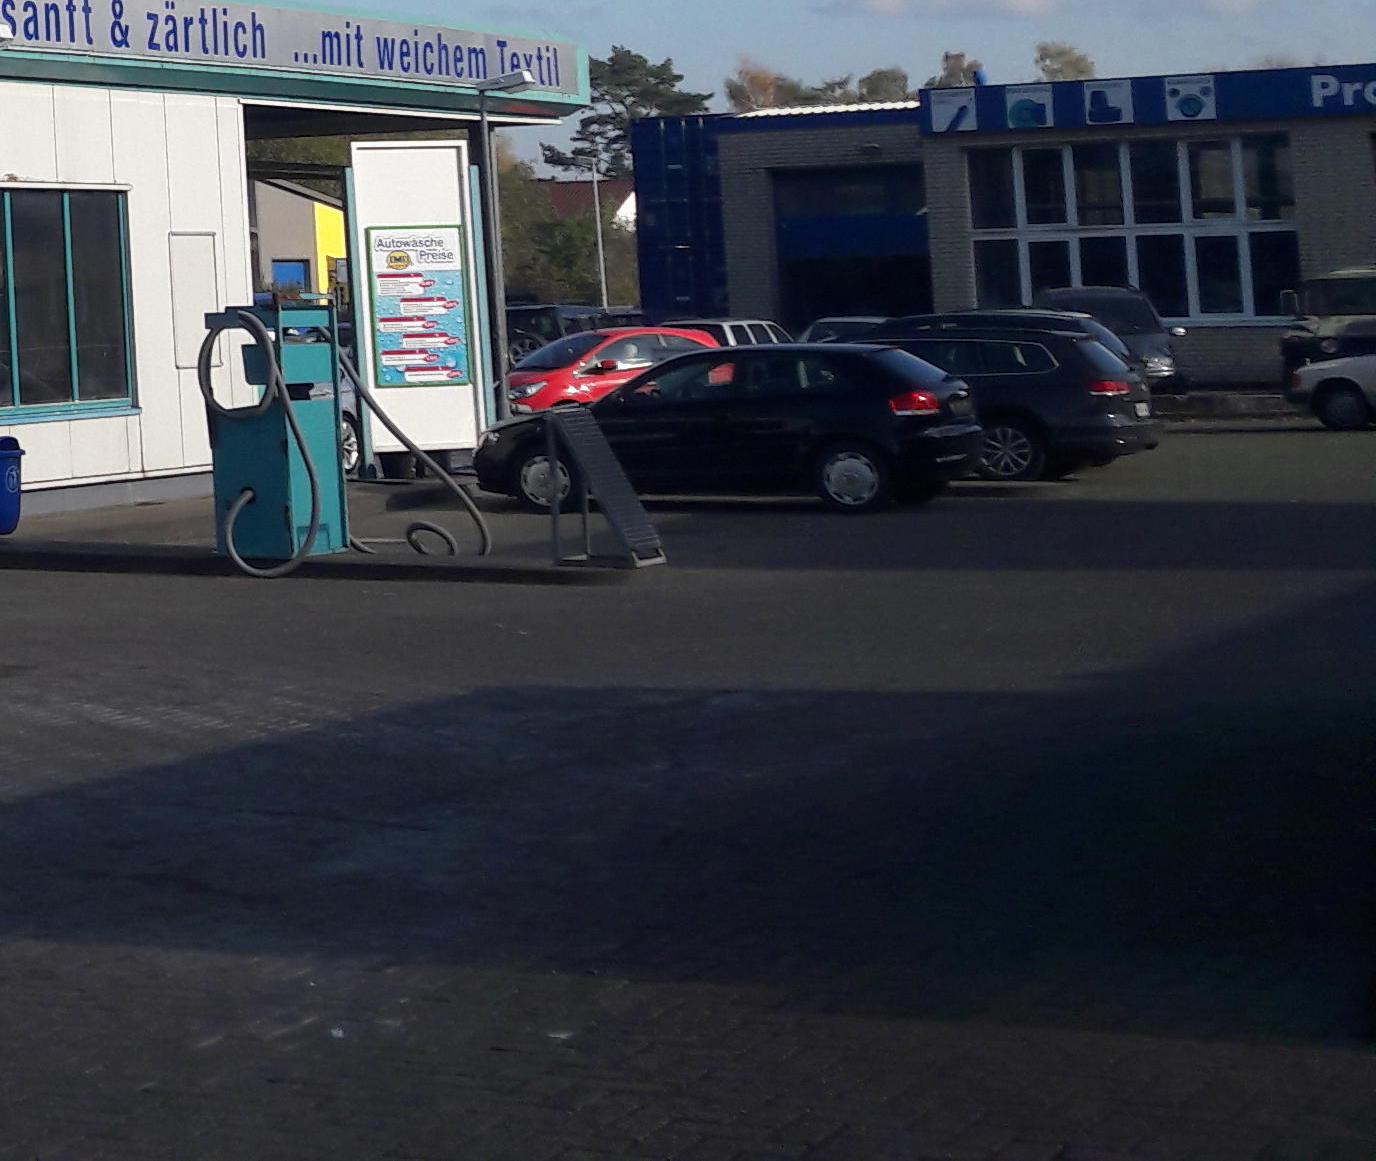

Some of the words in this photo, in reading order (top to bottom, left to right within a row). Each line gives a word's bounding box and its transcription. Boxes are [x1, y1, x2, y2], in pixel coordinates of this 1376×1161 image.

[146, 0, 267, 60] zärtlich
[375, 28, 487, 80] weichem
[419, 250, 454, 260] Preise
